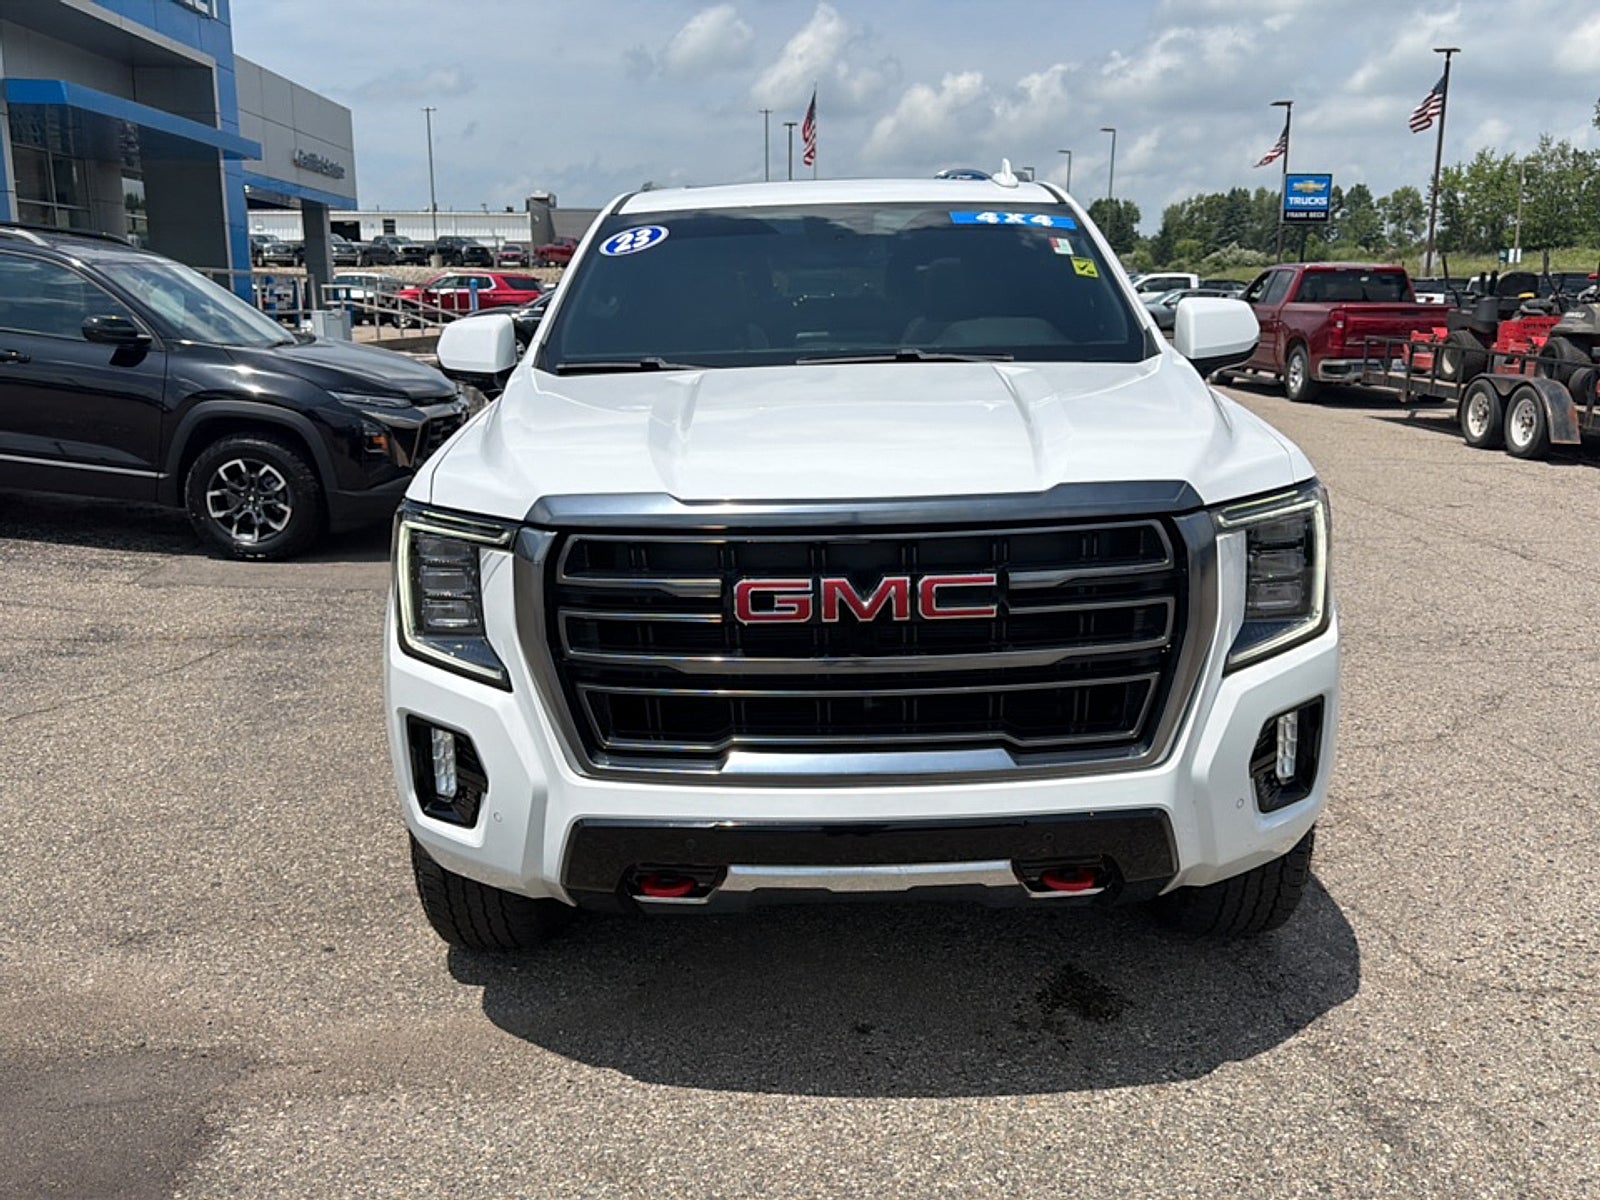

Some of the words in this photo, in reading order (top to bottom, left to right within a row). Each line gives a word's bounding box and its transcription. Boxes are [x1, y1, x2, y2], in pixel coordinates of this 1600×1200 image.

[1288, 196, 1328, 206] TRUCKS
[613, 229, 653, 253] 23
[734, 573, 998, 625] GMC
